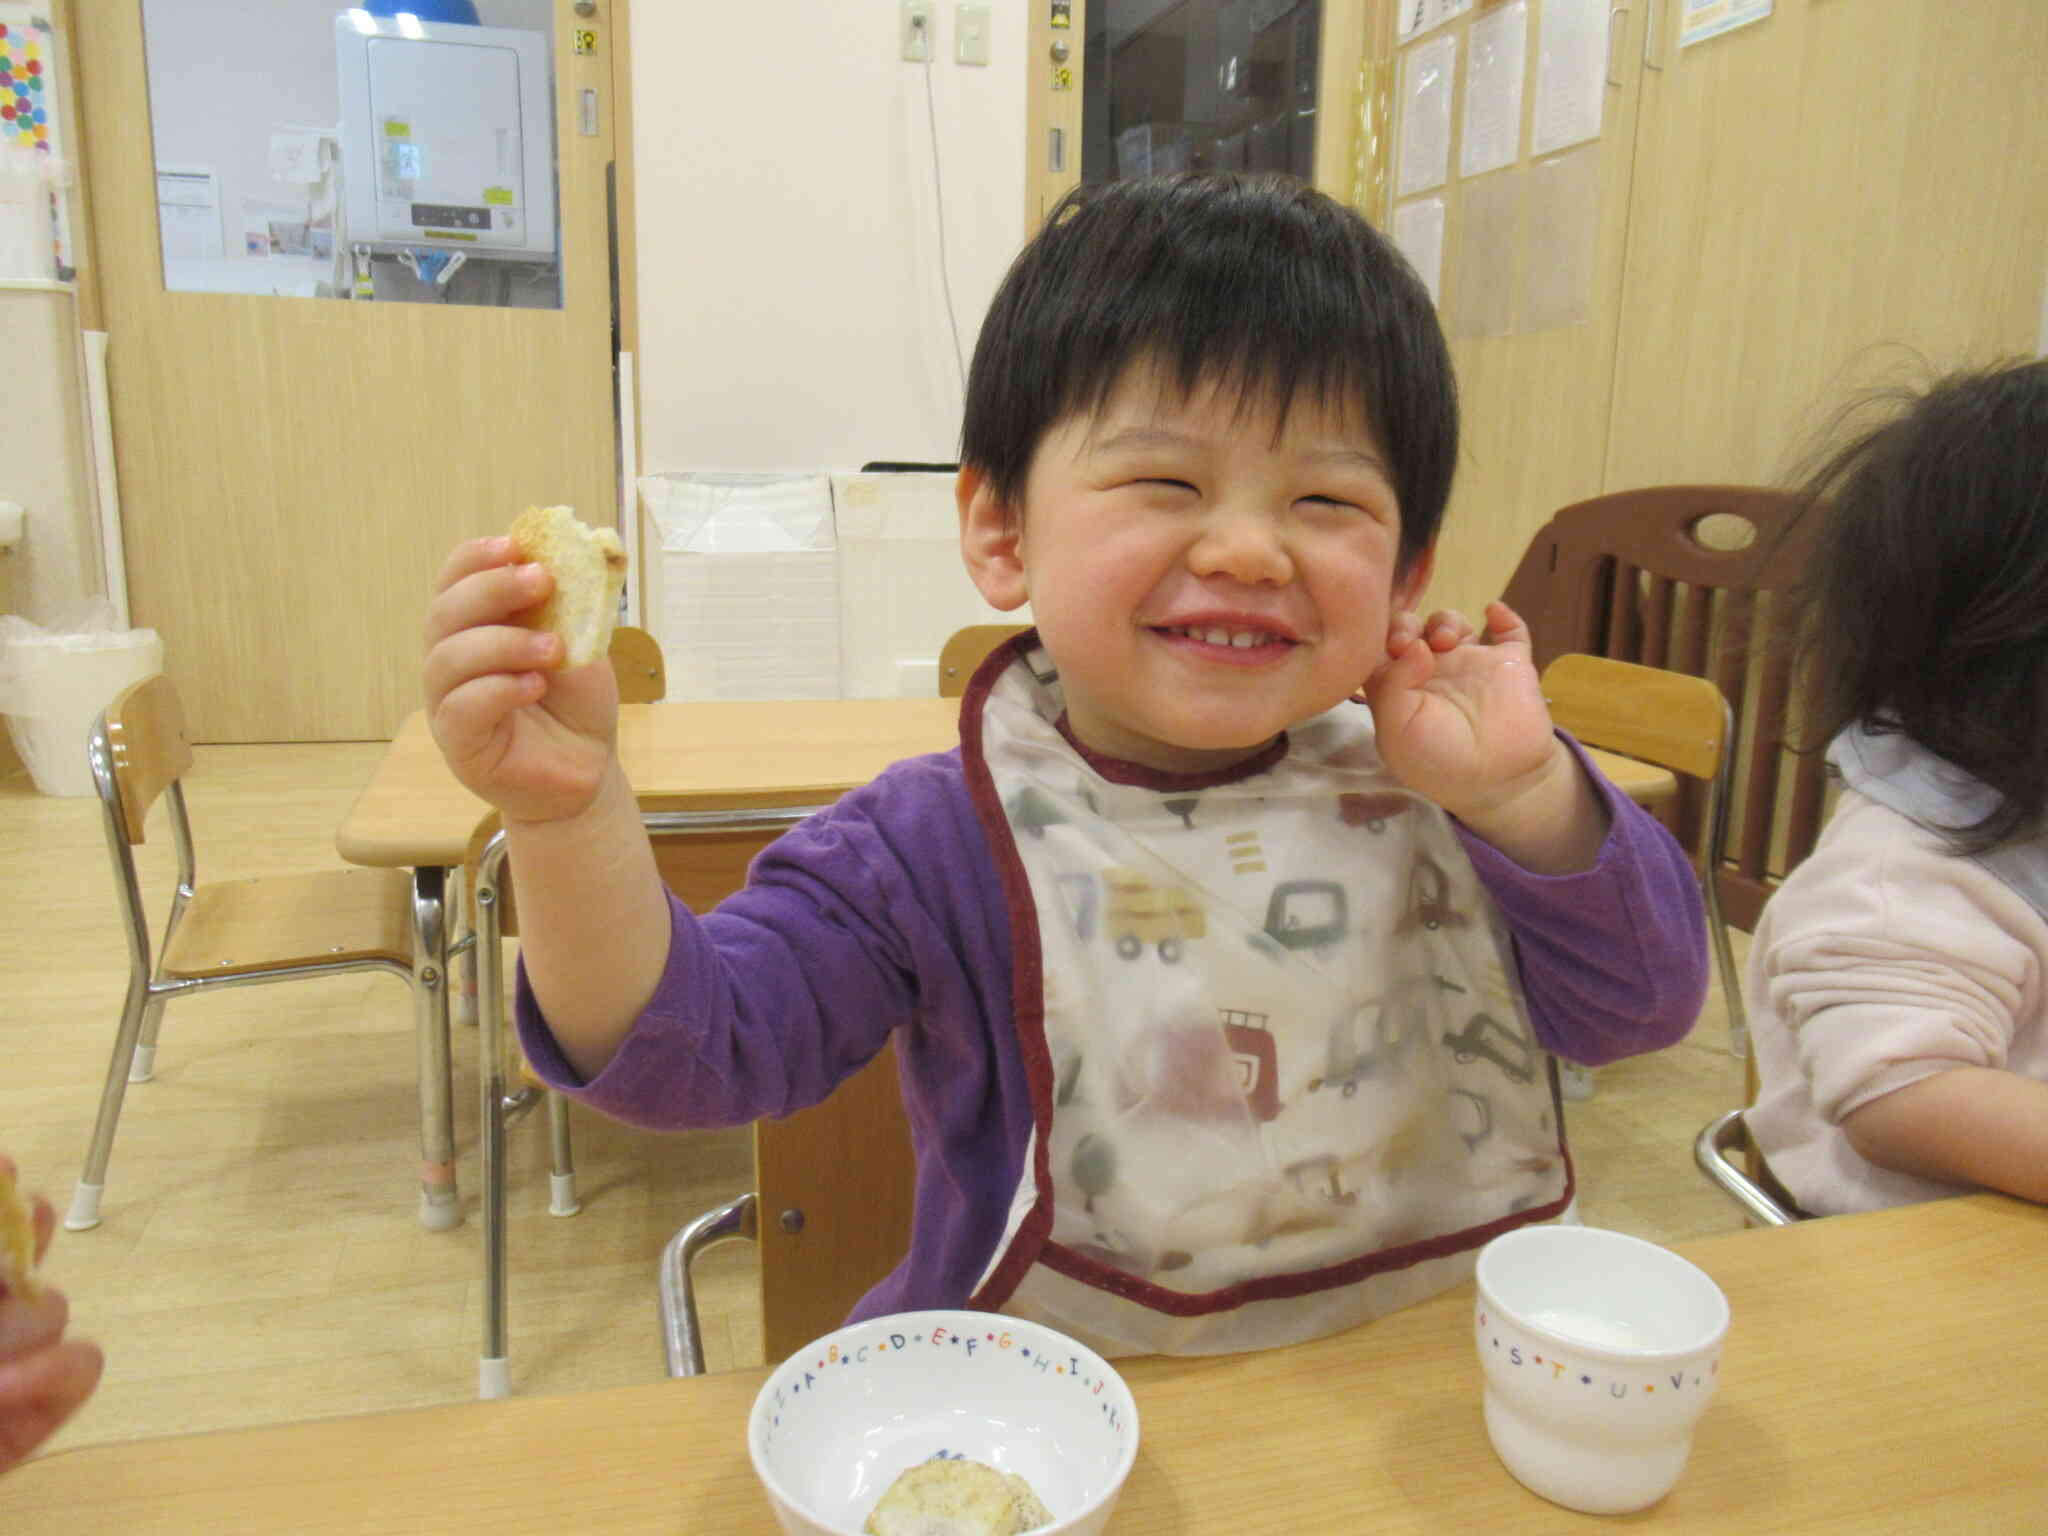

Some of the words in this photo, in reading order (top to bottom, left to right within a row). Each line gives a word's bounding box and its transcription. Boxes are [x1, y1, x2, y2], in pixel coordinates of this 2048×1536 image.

[804, 1372, 816, 1390] A
[829, 1344, 839, 1363] B
[856, 1345, 869, 1363] C
[890, 1334, 905, 1349] D
[931, 1327, 946, 1345] E
[966, 1338, 977, 1357] F
[999, 1331, 1013, 1349] G
[1033, 1354, 1049, 1373] H
[1069, 1357, 1078, 1375] I
[1093, 1380, 1104, 1396] J
[1510, 1347, 1522, 1365] S
[1551, 1360, 1565, 1379] T
[1610, 1381, 1627, 1399] U
[1670, 1371, 1684, 1390] V
